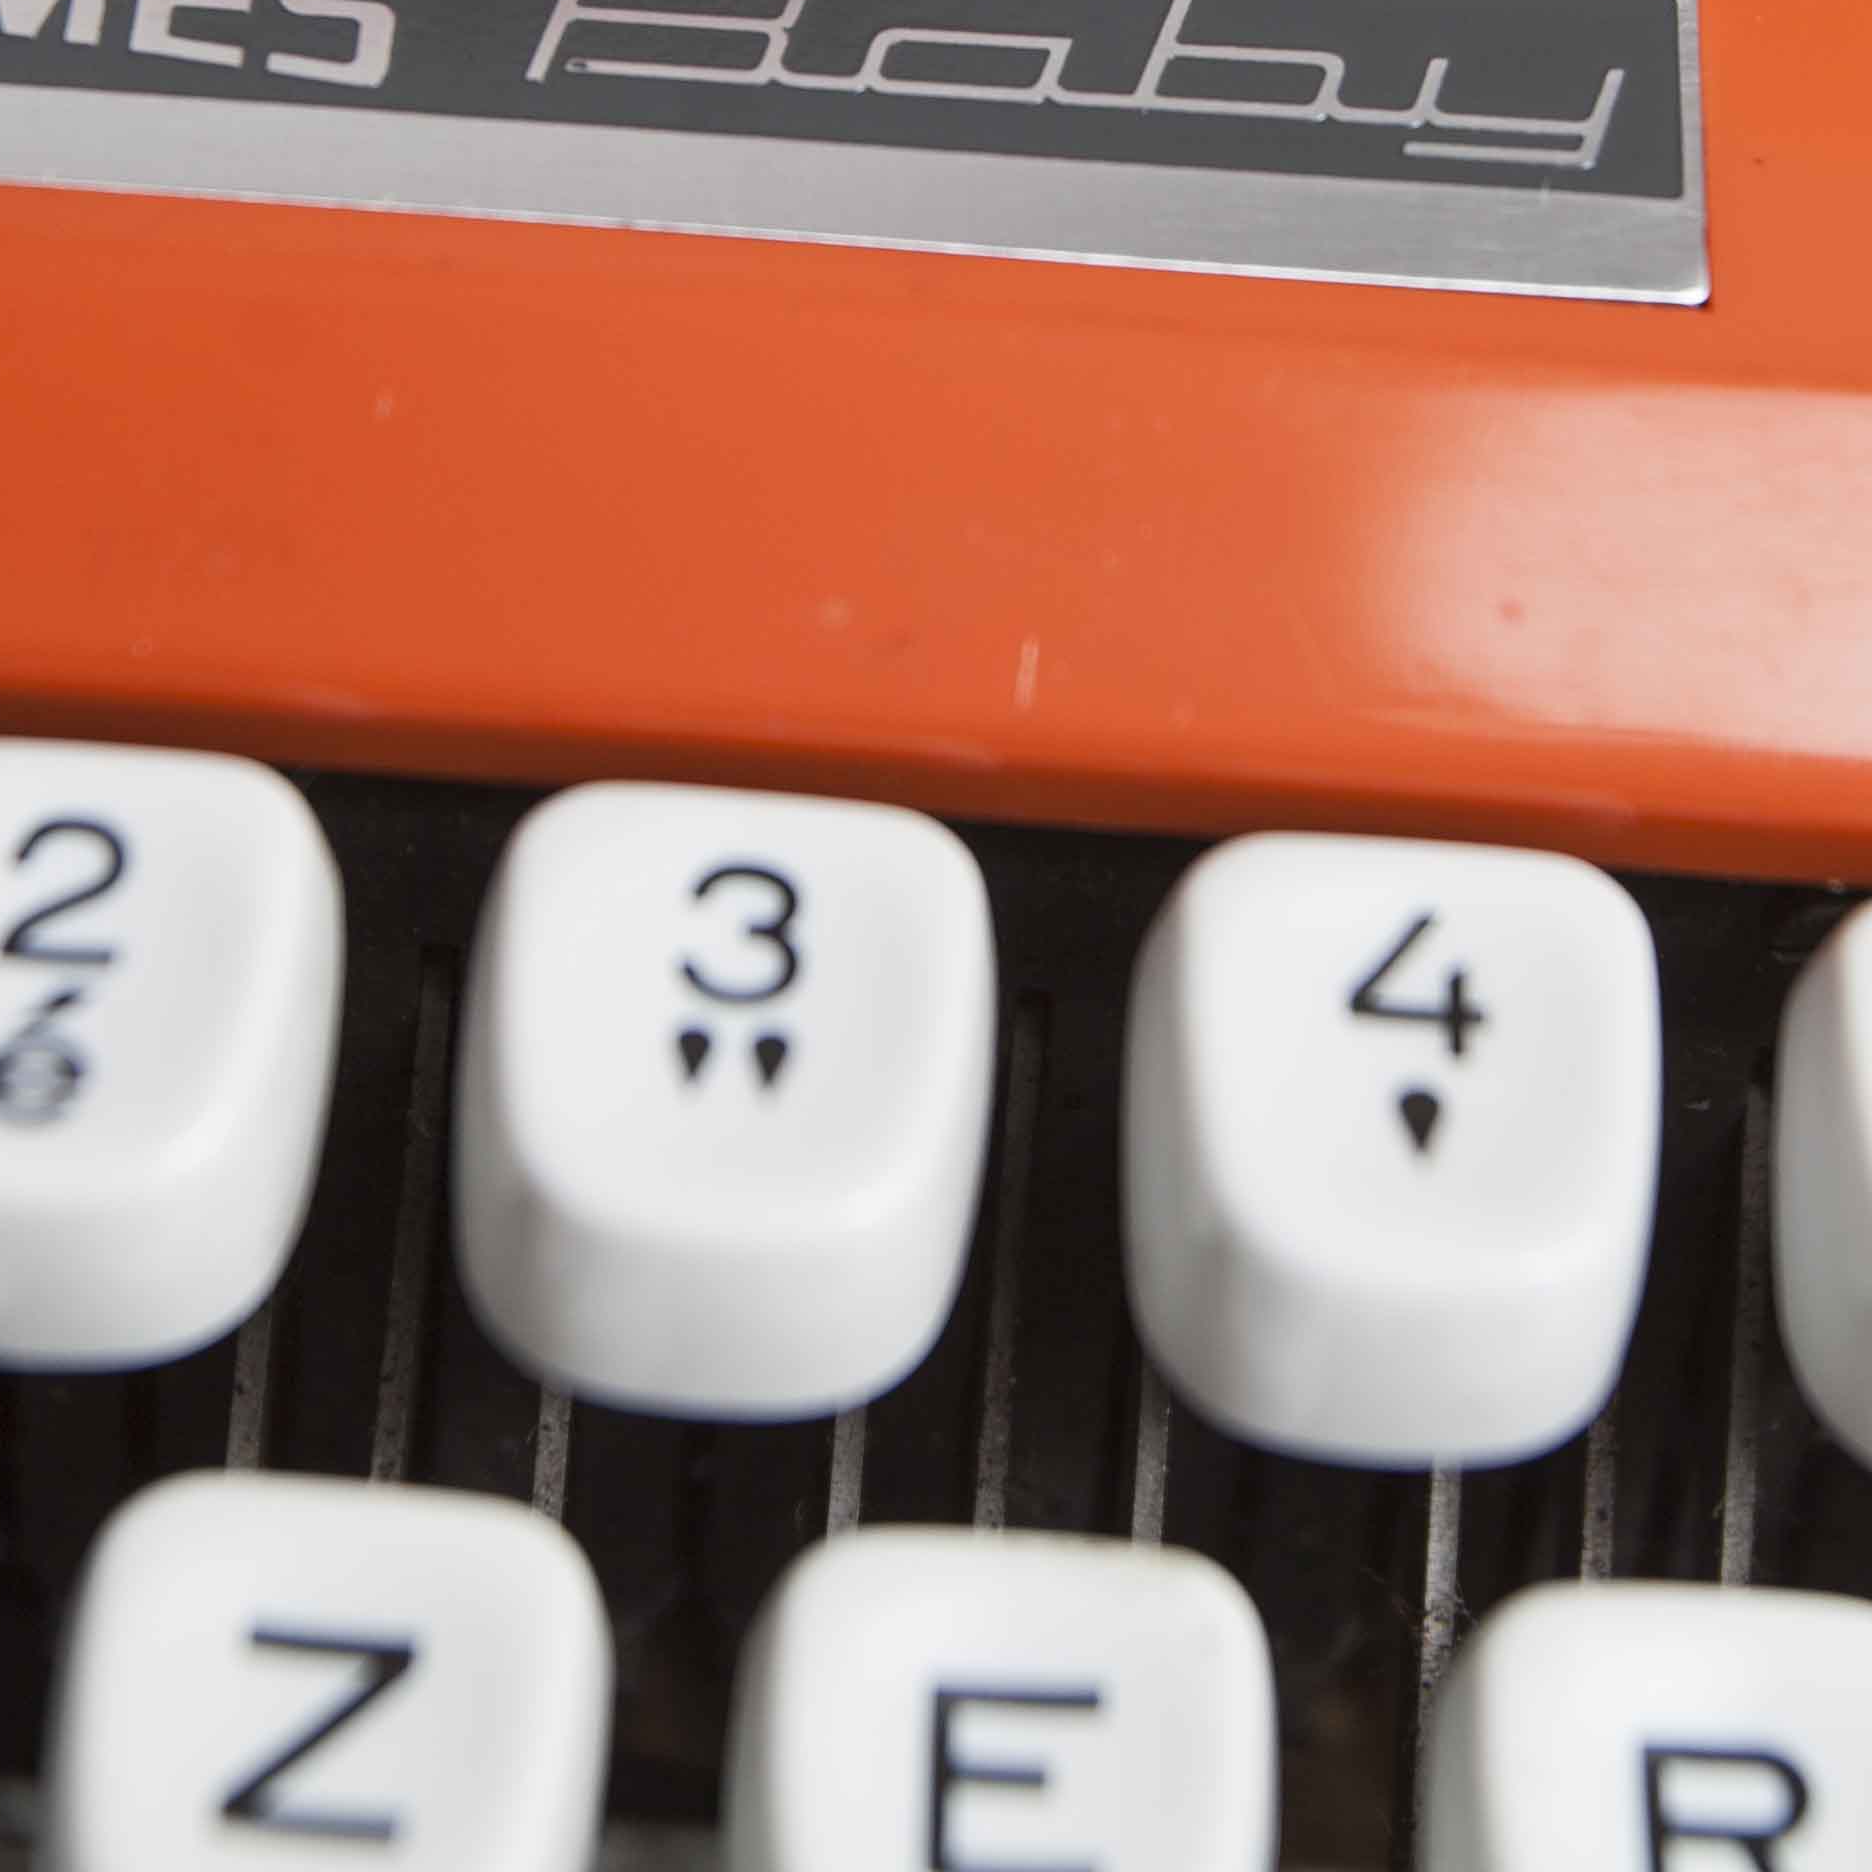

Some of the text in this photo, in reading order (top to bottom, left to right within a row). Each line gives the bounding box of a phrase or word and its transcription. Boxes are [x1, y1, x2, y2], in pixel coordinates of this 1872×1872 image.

[678, 861, 803, 1006] 3
[1345, 912, 1487, 1061] 4
[216, 1625, 421, 1847] Z
[922, 1683, 1104, 1872] E
[1638, 1743, 1815, 1872] R
